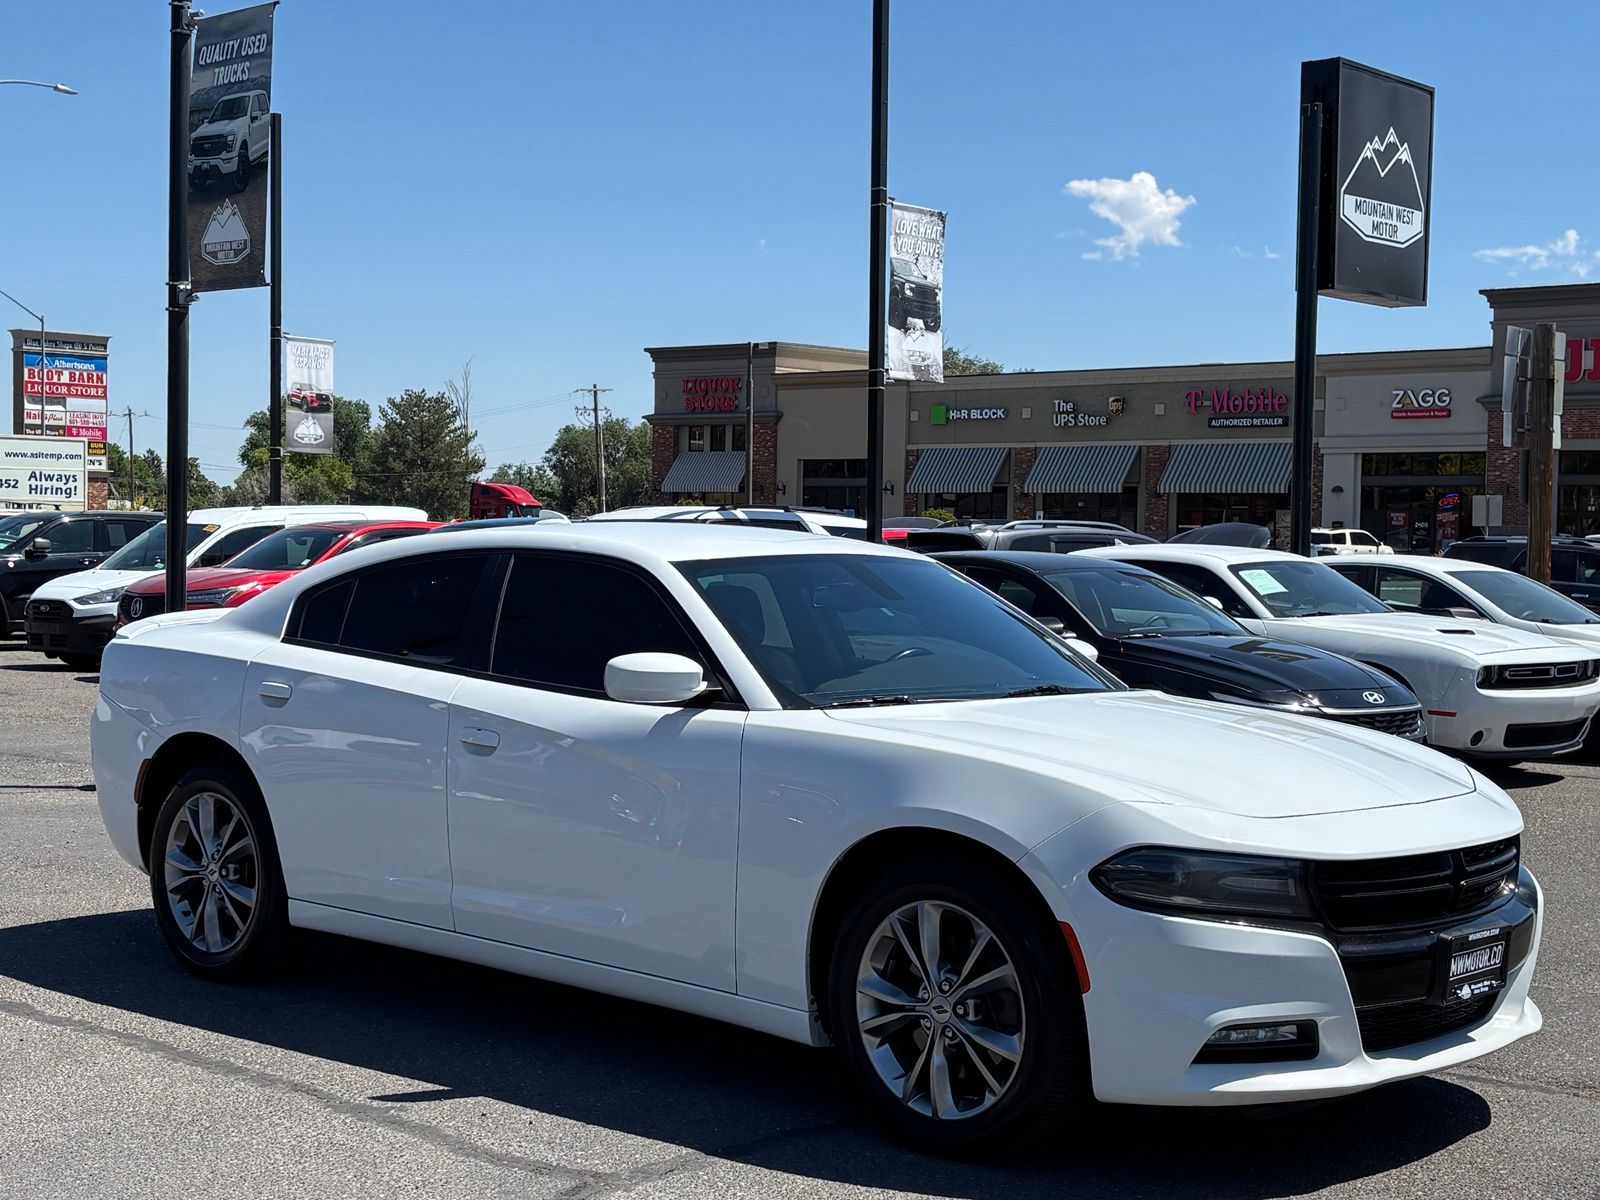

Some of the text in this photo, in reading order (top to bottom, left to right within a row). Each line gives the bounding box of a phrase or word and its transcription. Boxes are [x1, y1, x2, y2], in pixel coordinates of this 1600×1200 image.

[199, 33, 267, 65] QUALITY USED
[214, 61, 250, 86] TRUCKS
[1355, 198, 1414, 226] MOUNTAIN WEST
[895, 219, 941, 240] LOVE WHAT
[1372, 220, 1398, 239] MOTOR
[896, 236, 941, 258] YOU DRIVE
[291, 344, 329, 359] HABLAMOS
[53, 360, 95, 370] Albertsons
[27, 368, 104, 384] BOOT BARN
[70, 386, 105, 396] STORE
[681, 377, 740, 394] LIQUOR
[685, 395, 736, 411] STORE
[1053, 400, 1074, 412] The
[1183, 387, 1288, 415] T-Mobile
[1391, 388, 1451, 408] ZAGG
[950, 408, 1005, 420] H&R BLOCK
[1053, 413, 1107, 427] UPS Store
[1211, 417, 1283, 427] AUTHORIZED RETAILER
[4, 451, 82, 461] www.asitemp.com
[27, 471, 78, 485] Always
[28, 484, 77, 498] Hiring!
[1450, 944, 1502, 977] MWMOTOR.CO
